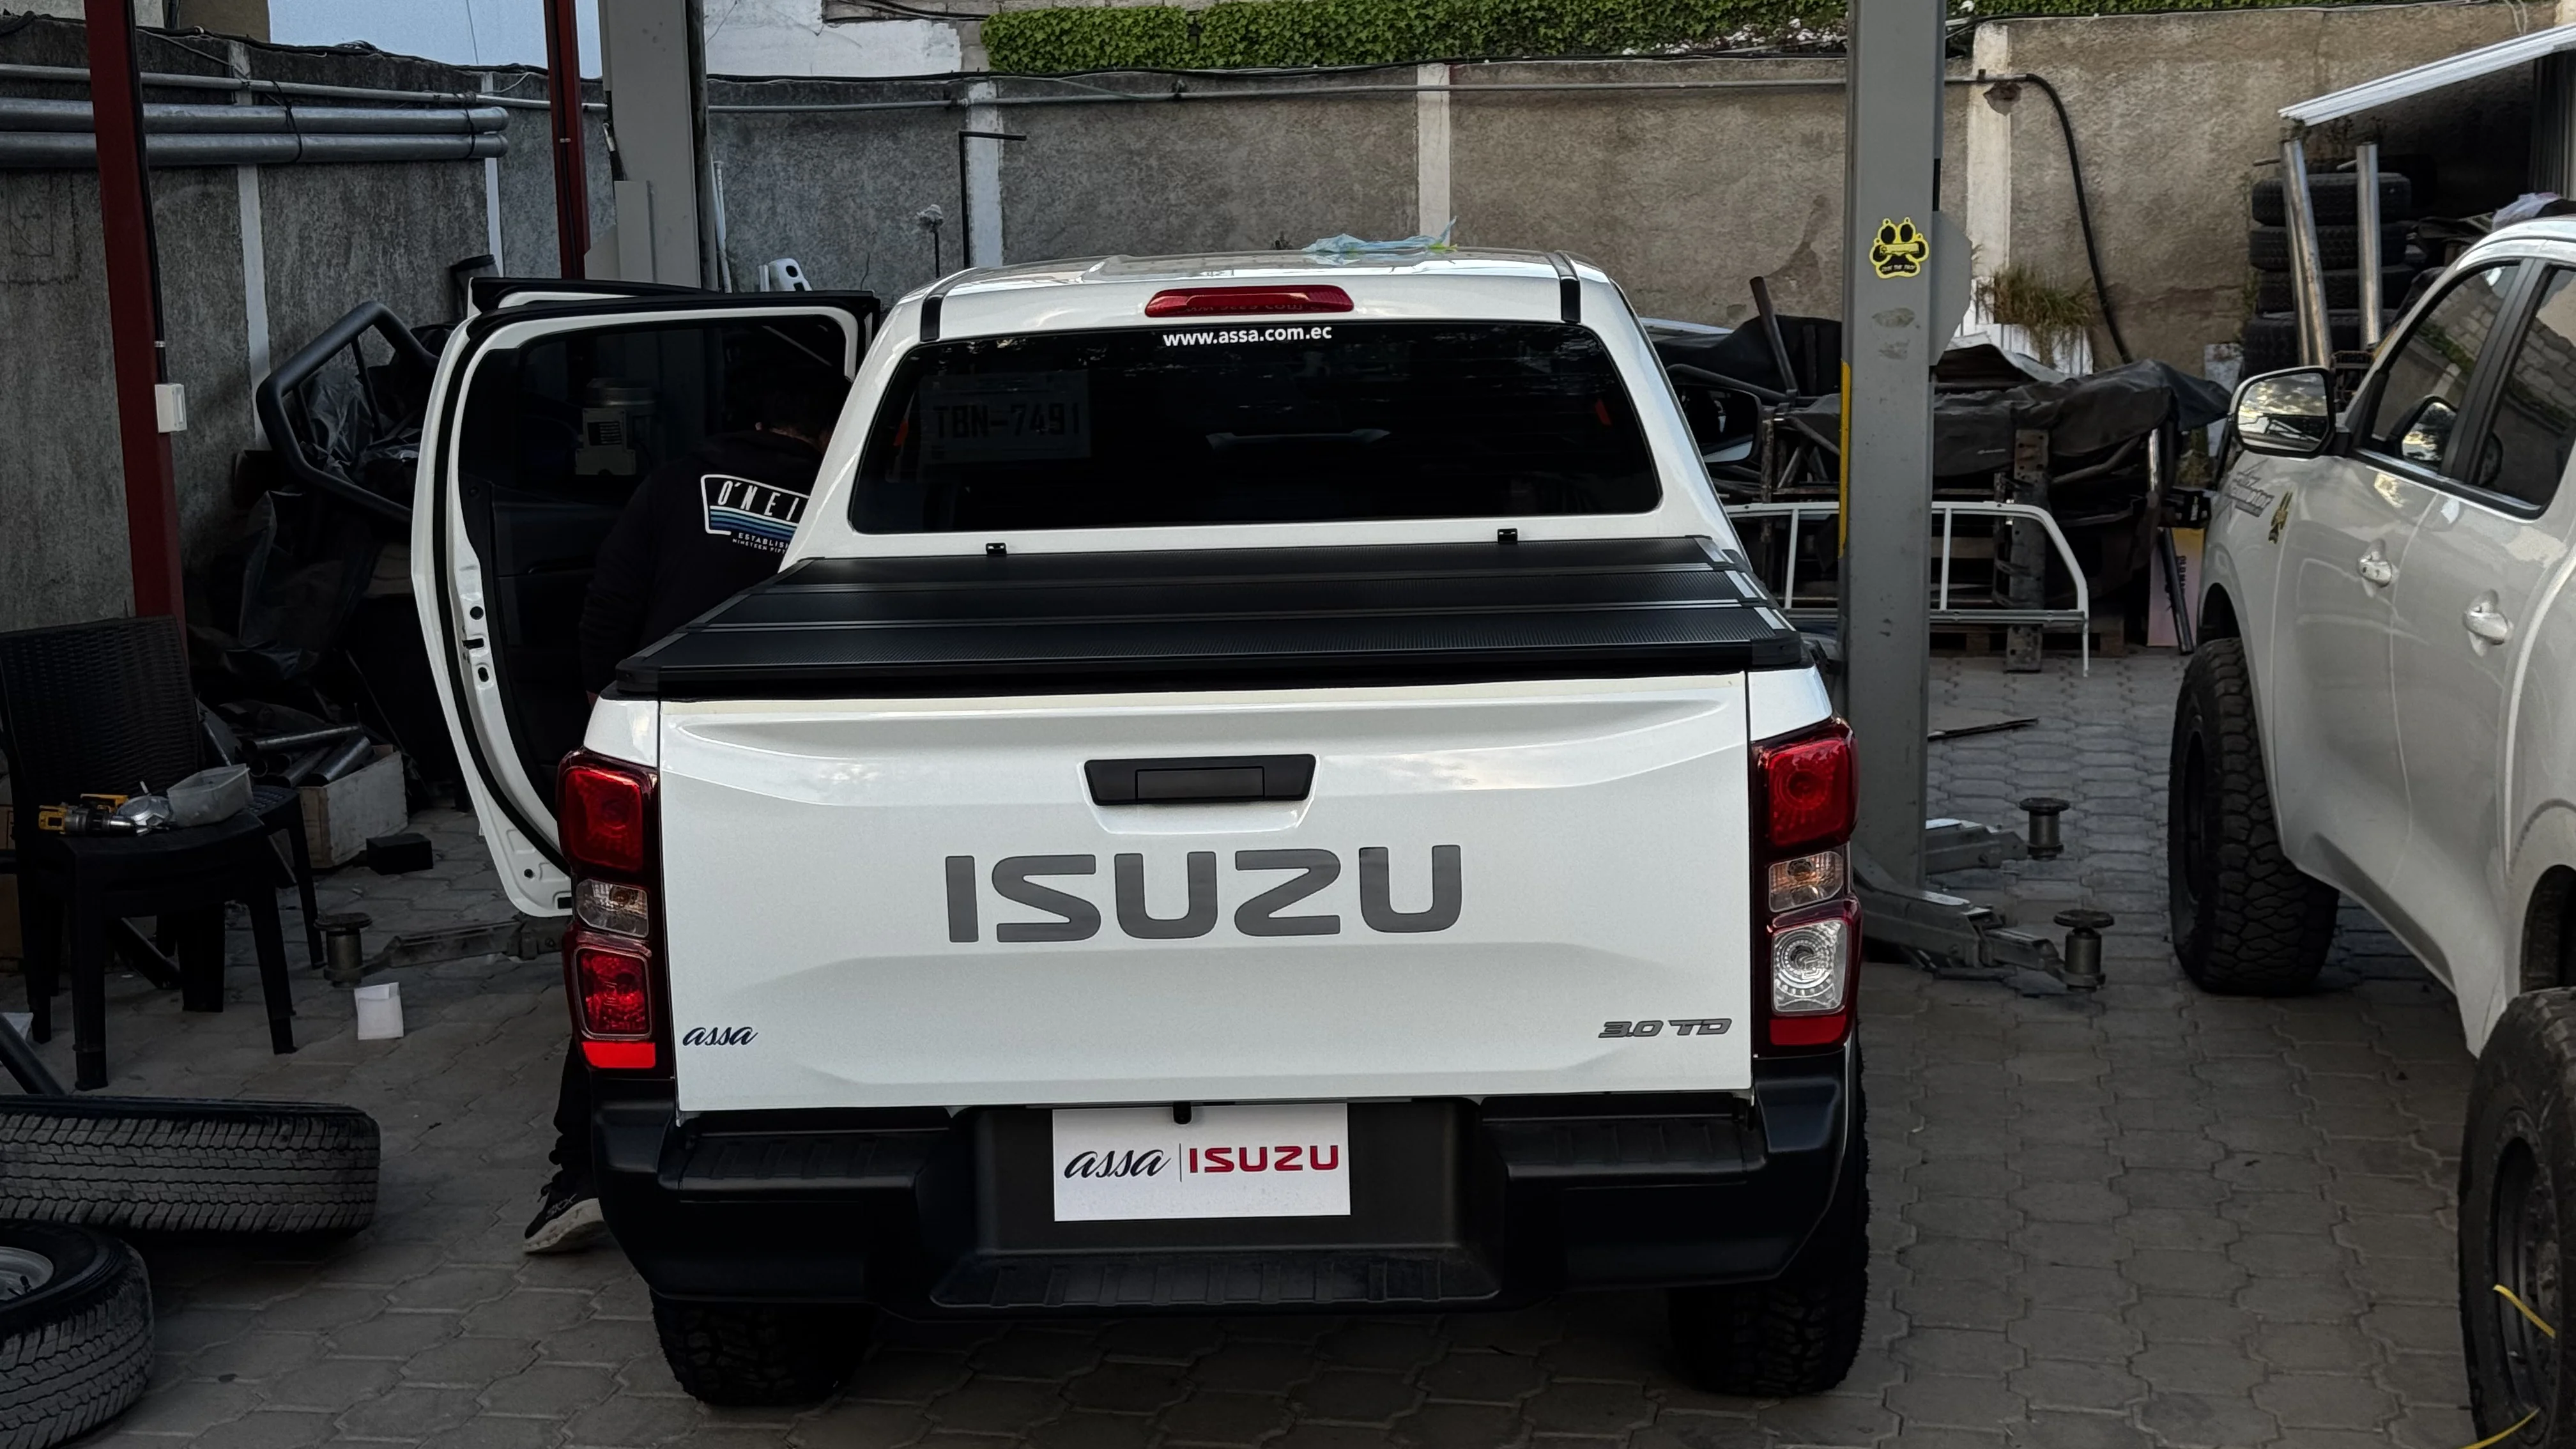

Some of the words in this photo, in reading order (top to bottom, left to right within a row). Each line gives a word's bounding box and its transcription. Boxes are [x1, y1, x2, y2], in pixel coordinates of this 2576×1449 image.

[1163, 326, 1333, 347] www.assa.com.ec
[933, 402, 1080, 439] TBN-7491
[738, 532, 788, 549] ESTABLIS
[945, 844, 1462, 943] ISUZU
[682, 1025, 759, 1047] assa
[1598, 1020, 1664, 1039] 3.0
[1667, 1017, 1733, 1036] TD
[1063, 1148, 1171, 1179] assa
[1189, 1144, 1340, 1174] ISUZU
